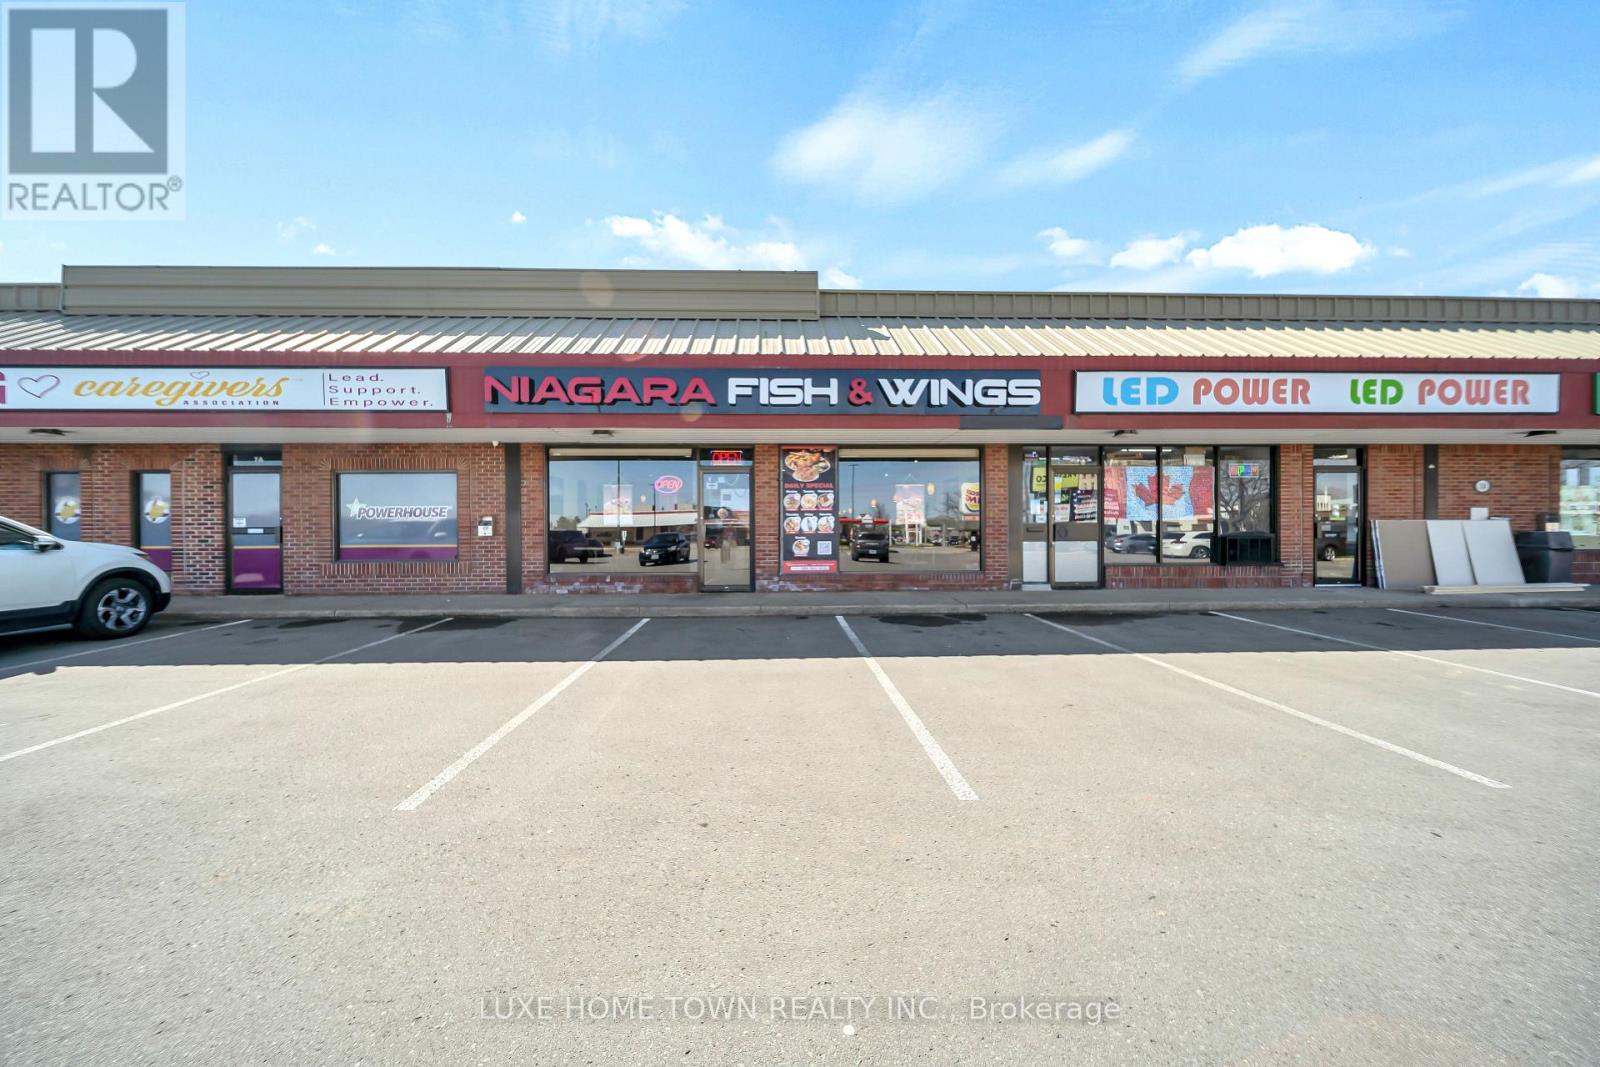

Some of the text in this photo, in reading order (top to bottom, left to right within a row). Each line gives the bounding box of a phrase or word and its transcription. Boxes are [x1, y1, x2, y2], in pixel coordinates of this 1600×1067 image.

[328, 373, 384, 382] Lead.
[73, 376, 289, 407] caregivers
[328, 385, 421, 396] Support.
[484, 376, 1041, 406] NIAGARA FISH & WINGS
[1102, 376, 1311, 406] LED POWER
[1349, 378, 1531, 405] LED POWER
[329, 397, 433, 408] Empower.
[711, 451, 742, 465] OPEN
[657, 478, 681, 490] OPEN
[356, 506, 448, 519] POWERHOUSE
